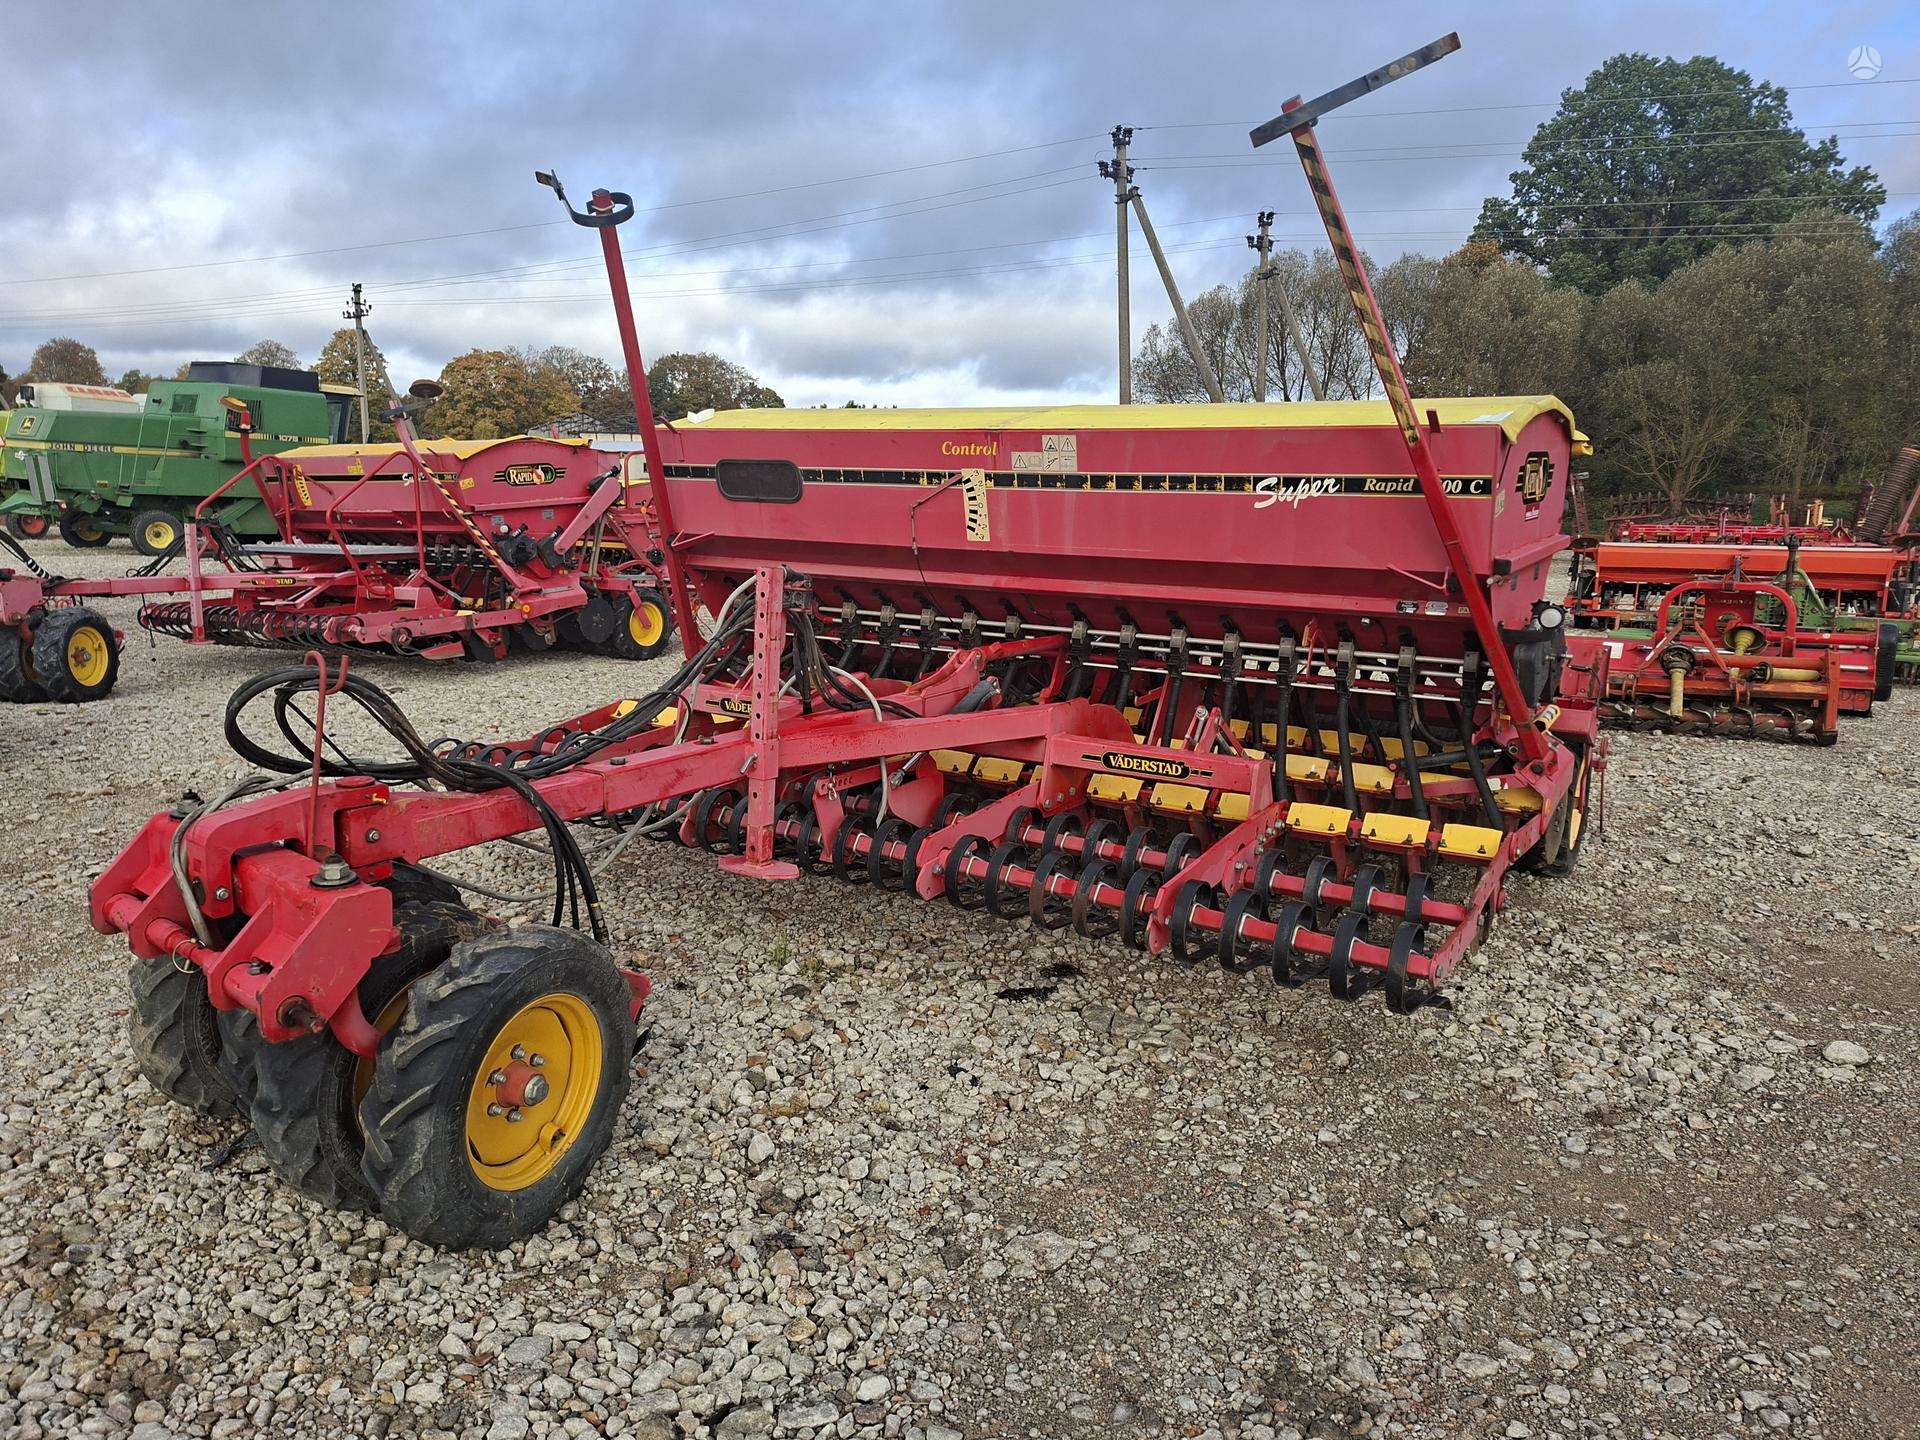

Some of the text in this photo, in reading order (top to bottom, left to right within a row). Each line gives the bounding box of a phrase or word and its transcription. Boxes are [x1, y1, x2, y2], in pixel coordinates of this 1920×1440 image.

[48, 442, 115, 454] JOHN DEERE
[941, 440, 998, 456] Control
[509, 469, 533, 485] RAPID
[1253, 476, 1483, 509] Super Rapid 00 C
[1109, 754, 1182, 776] VÄDERSTAD
